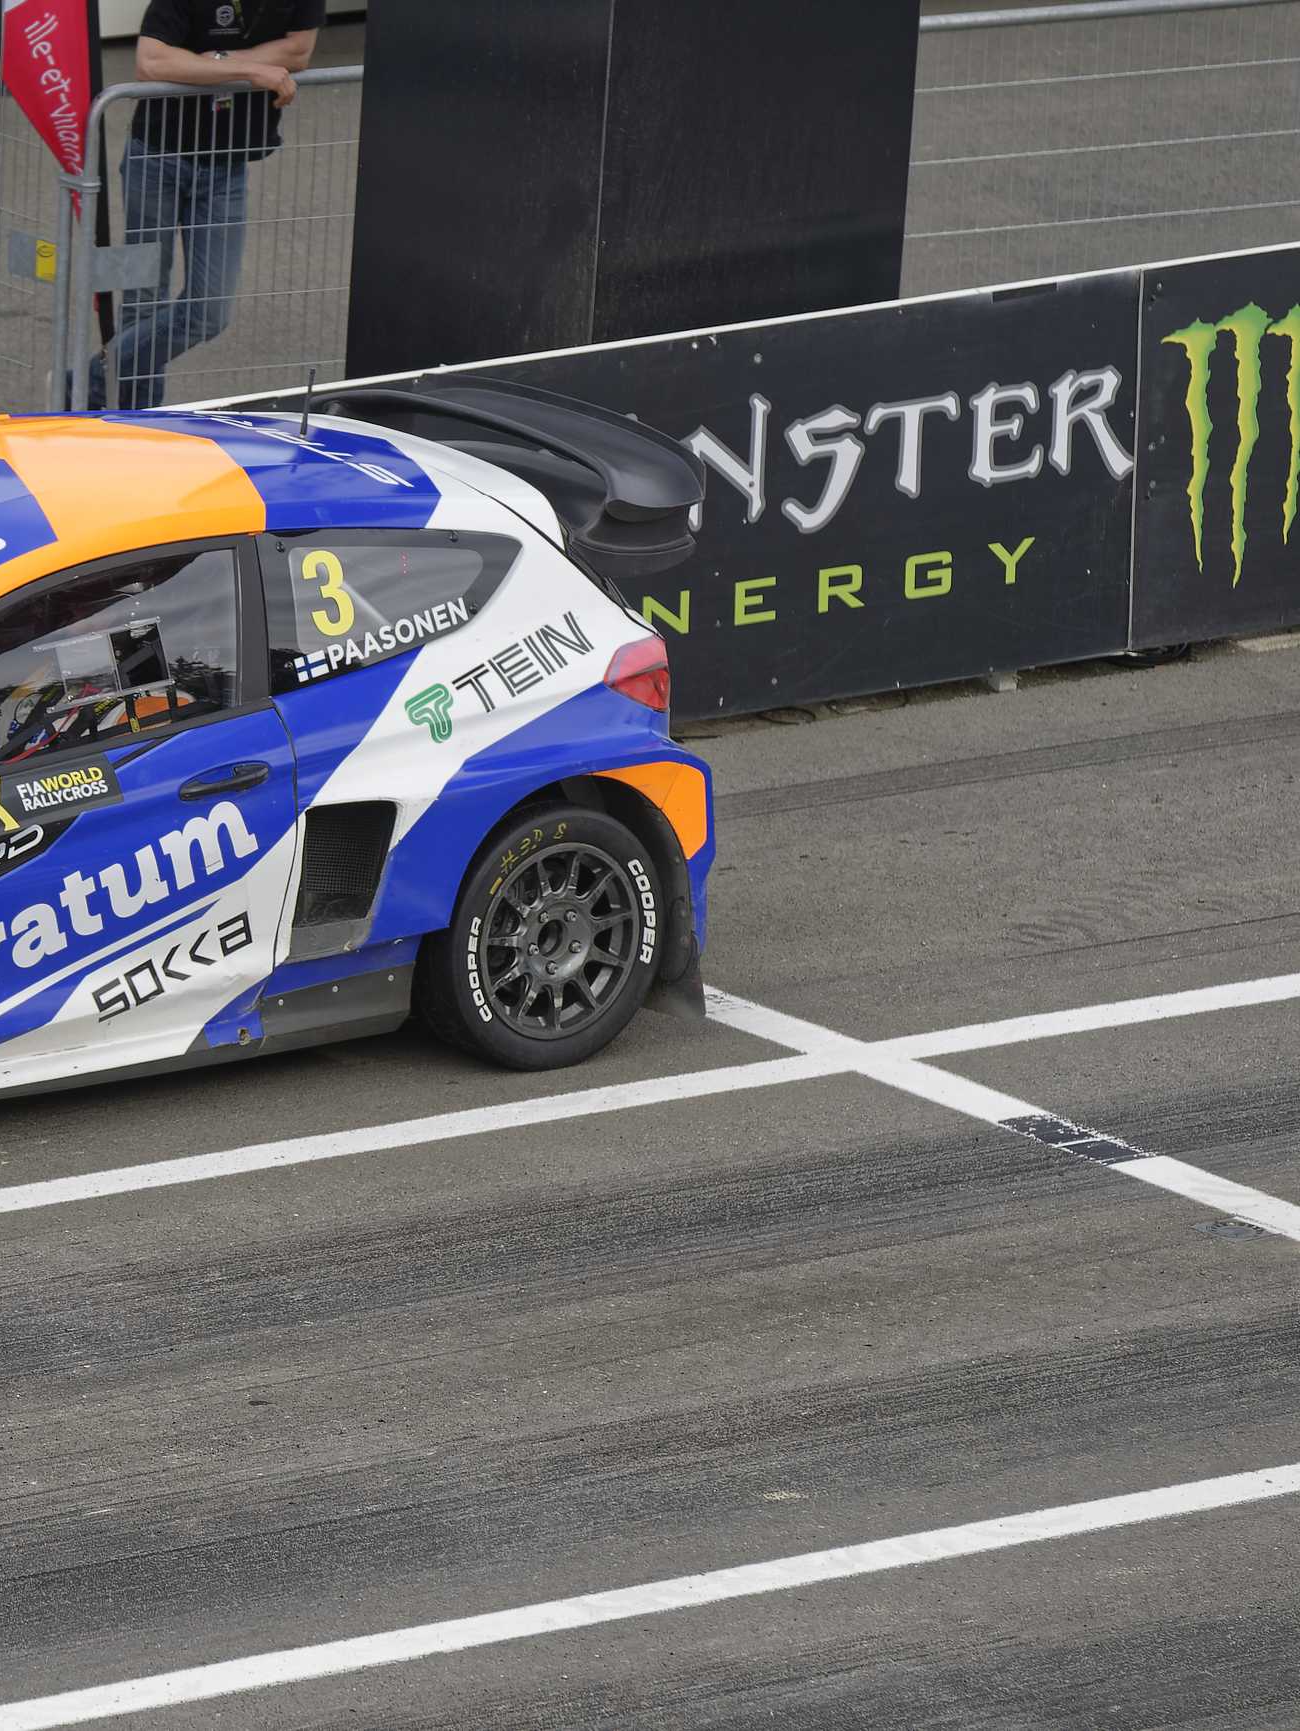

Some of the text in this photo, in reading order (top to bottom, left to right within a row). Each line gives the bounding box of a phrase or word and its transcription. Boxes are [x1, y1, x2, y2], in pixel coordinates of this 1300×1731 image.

[301, 550, 355, 636] 3
[642, 537, 1035, 634] NERGY
[328, 597, 470, 672] PAASONEN
[452, 610, 595, 713] TEIN
[22, 780, 109, 812] RALLYCROSS
[627, 858, 658, 965] COOPER
[467, 916, 493, 1023] COOPER
